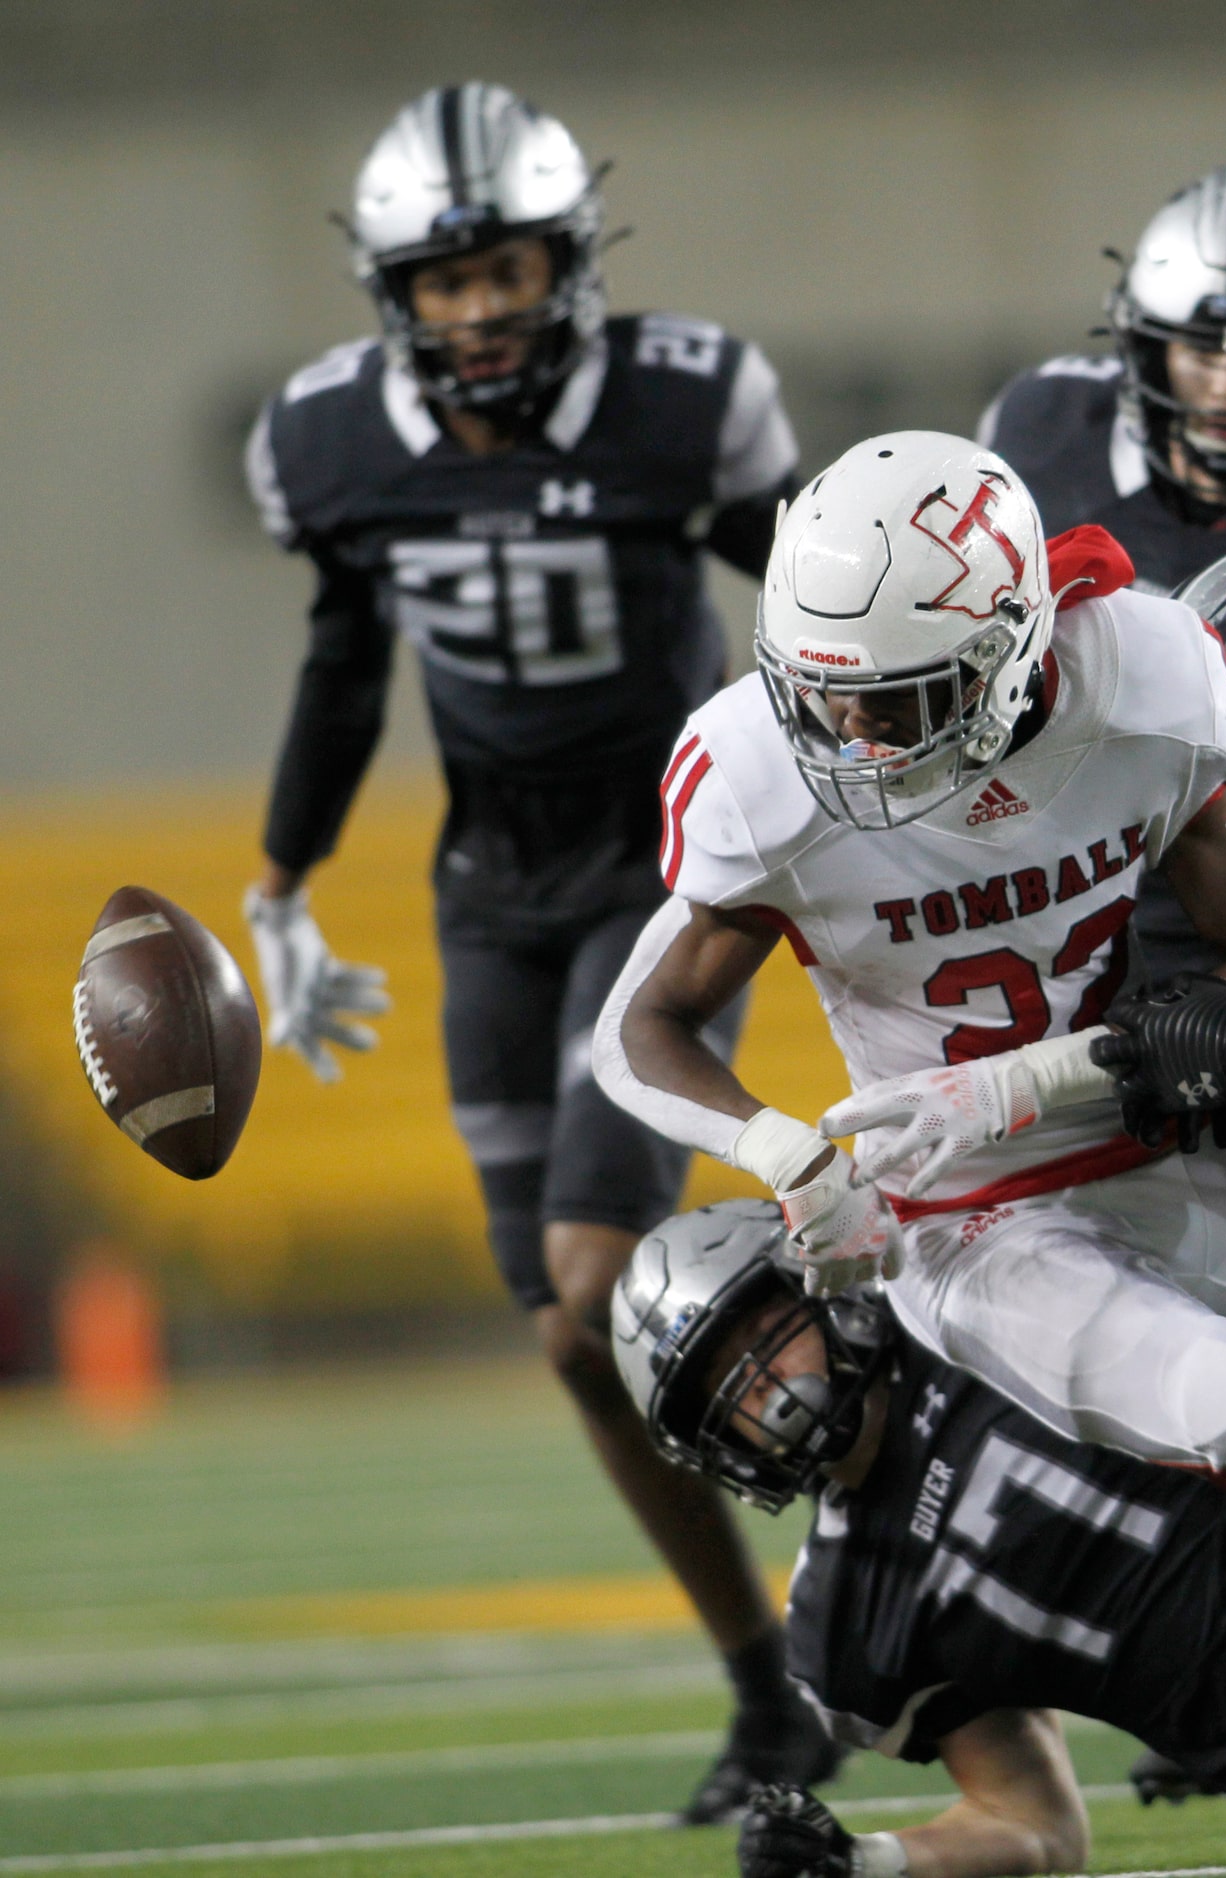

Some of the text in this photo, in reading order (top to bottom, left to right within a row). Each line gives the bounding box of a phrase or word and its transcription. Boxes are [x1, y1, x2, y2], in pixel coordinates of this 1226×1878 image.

[386, 535, 627, 688] 20
[964, 799, 1032, 828] adidas
[873, 822, 1149, 945] TOMBALL
[922, 945, 1138, 1068] 22
[909, 1457, 956, 1543] GUYER
[914, 1433, 1165, 1662] 17
